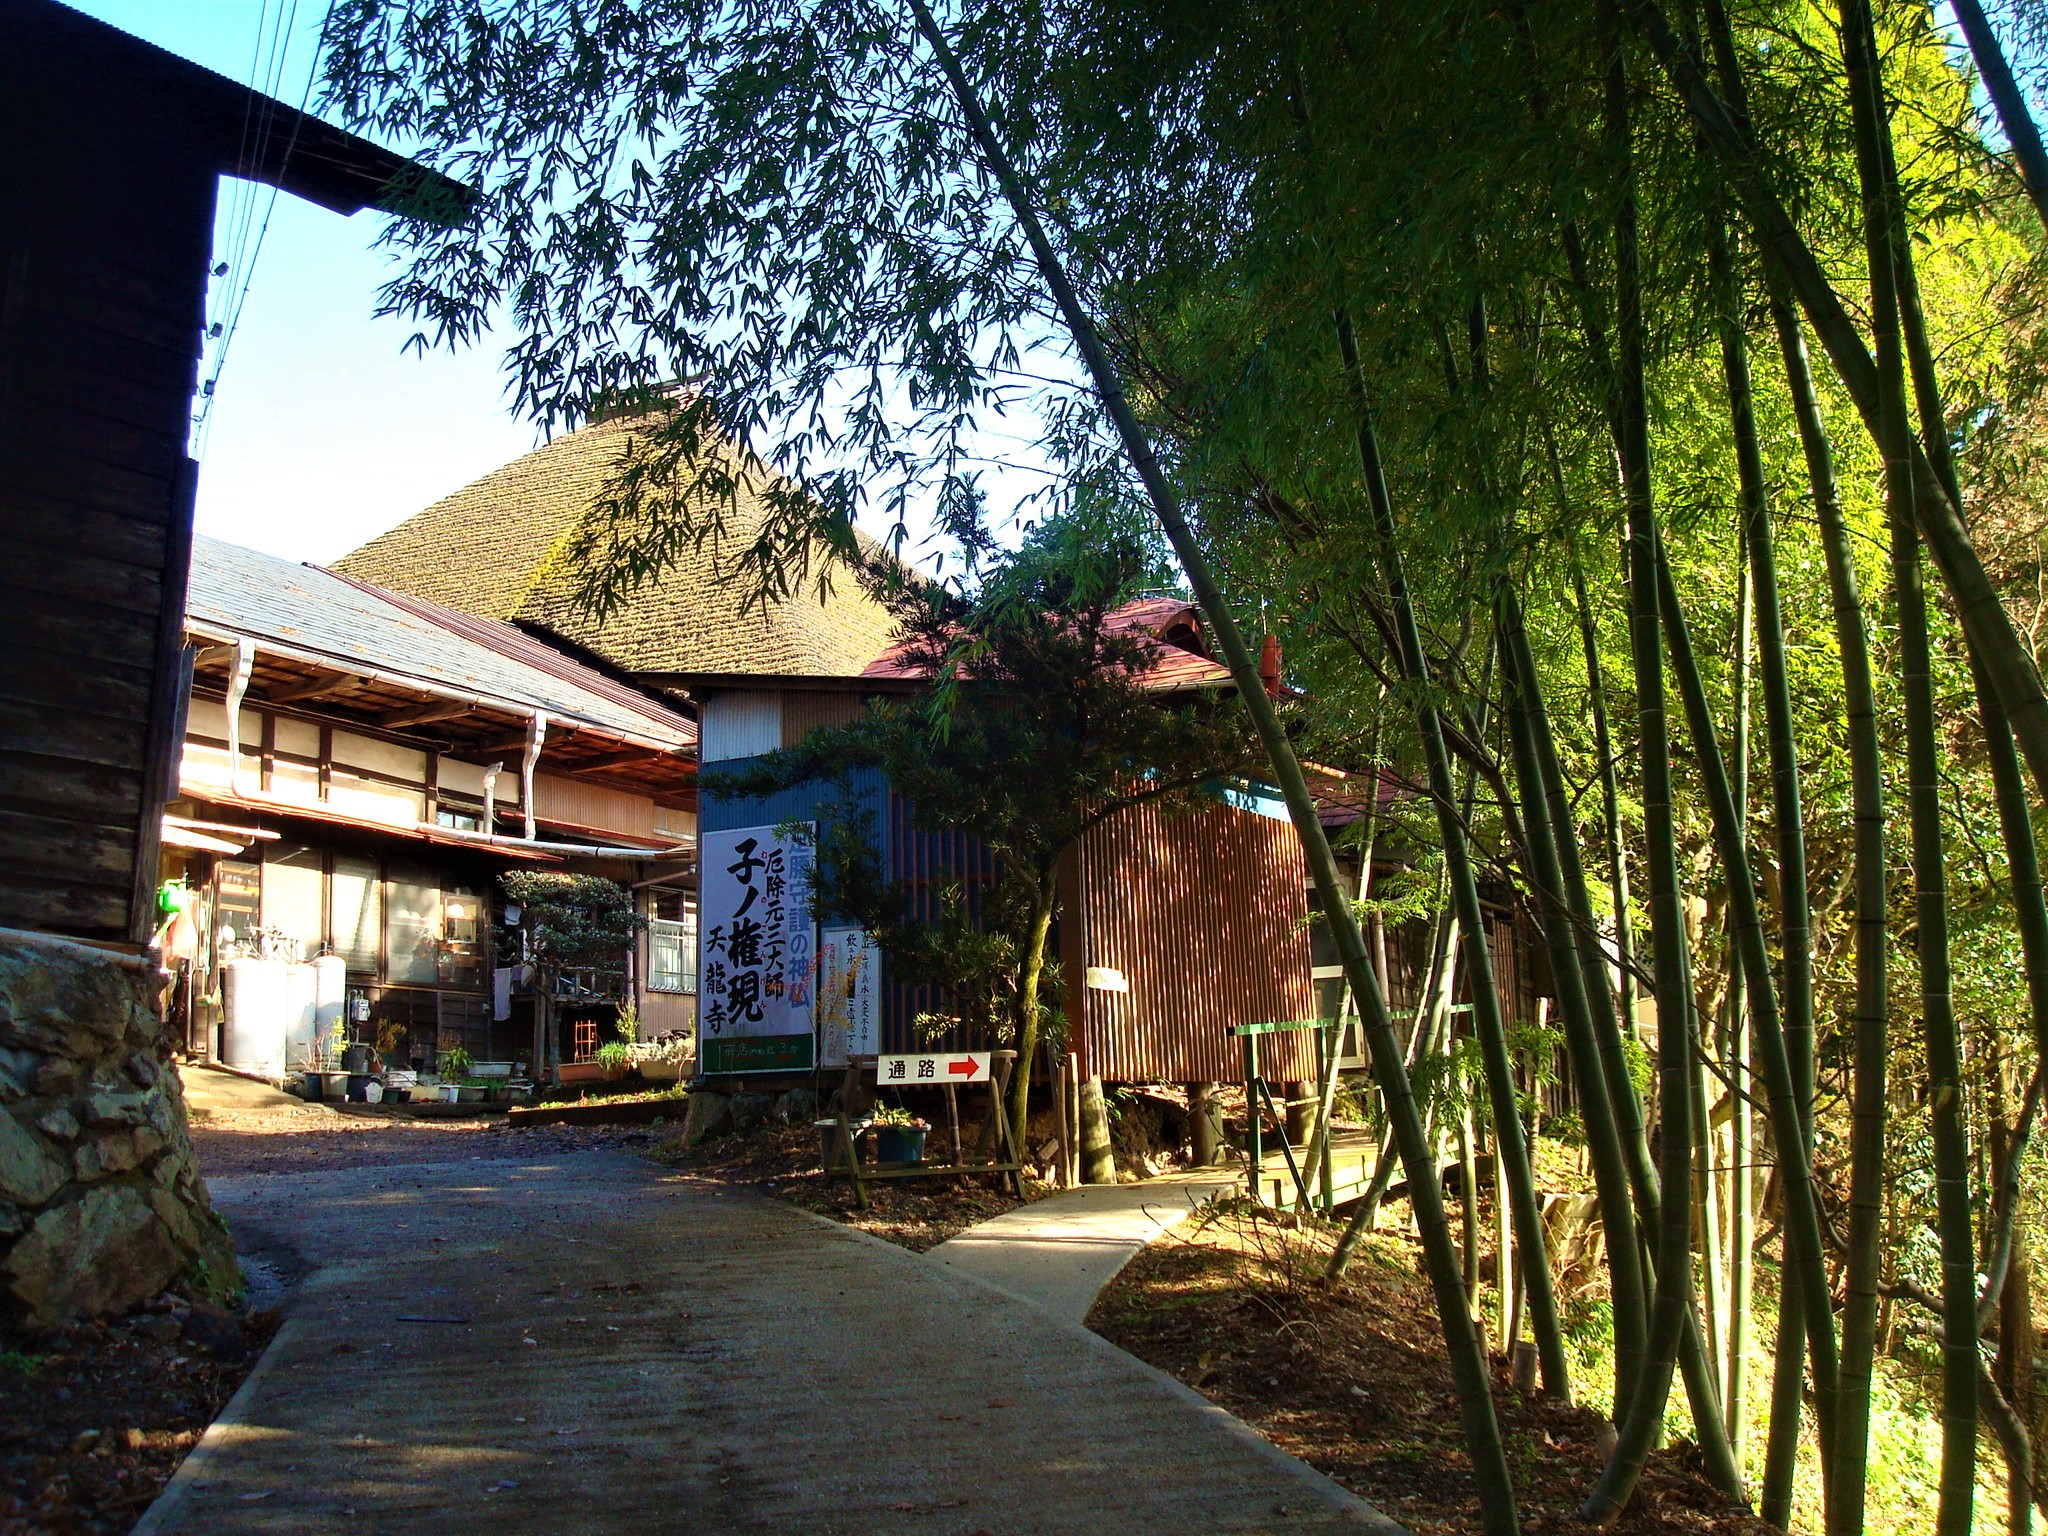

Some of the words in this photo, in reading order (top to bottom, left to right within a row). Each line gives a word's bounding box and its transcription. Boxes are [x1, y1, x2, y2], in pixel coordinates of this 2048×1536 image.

[704, 926, 728, 1035] 天龍寺
[727, 838, 766, 1025] 子ノ権現
[764, 848, 787, 1001] 厄除元三大師
[888, 1060, 936, 1079] 通路
